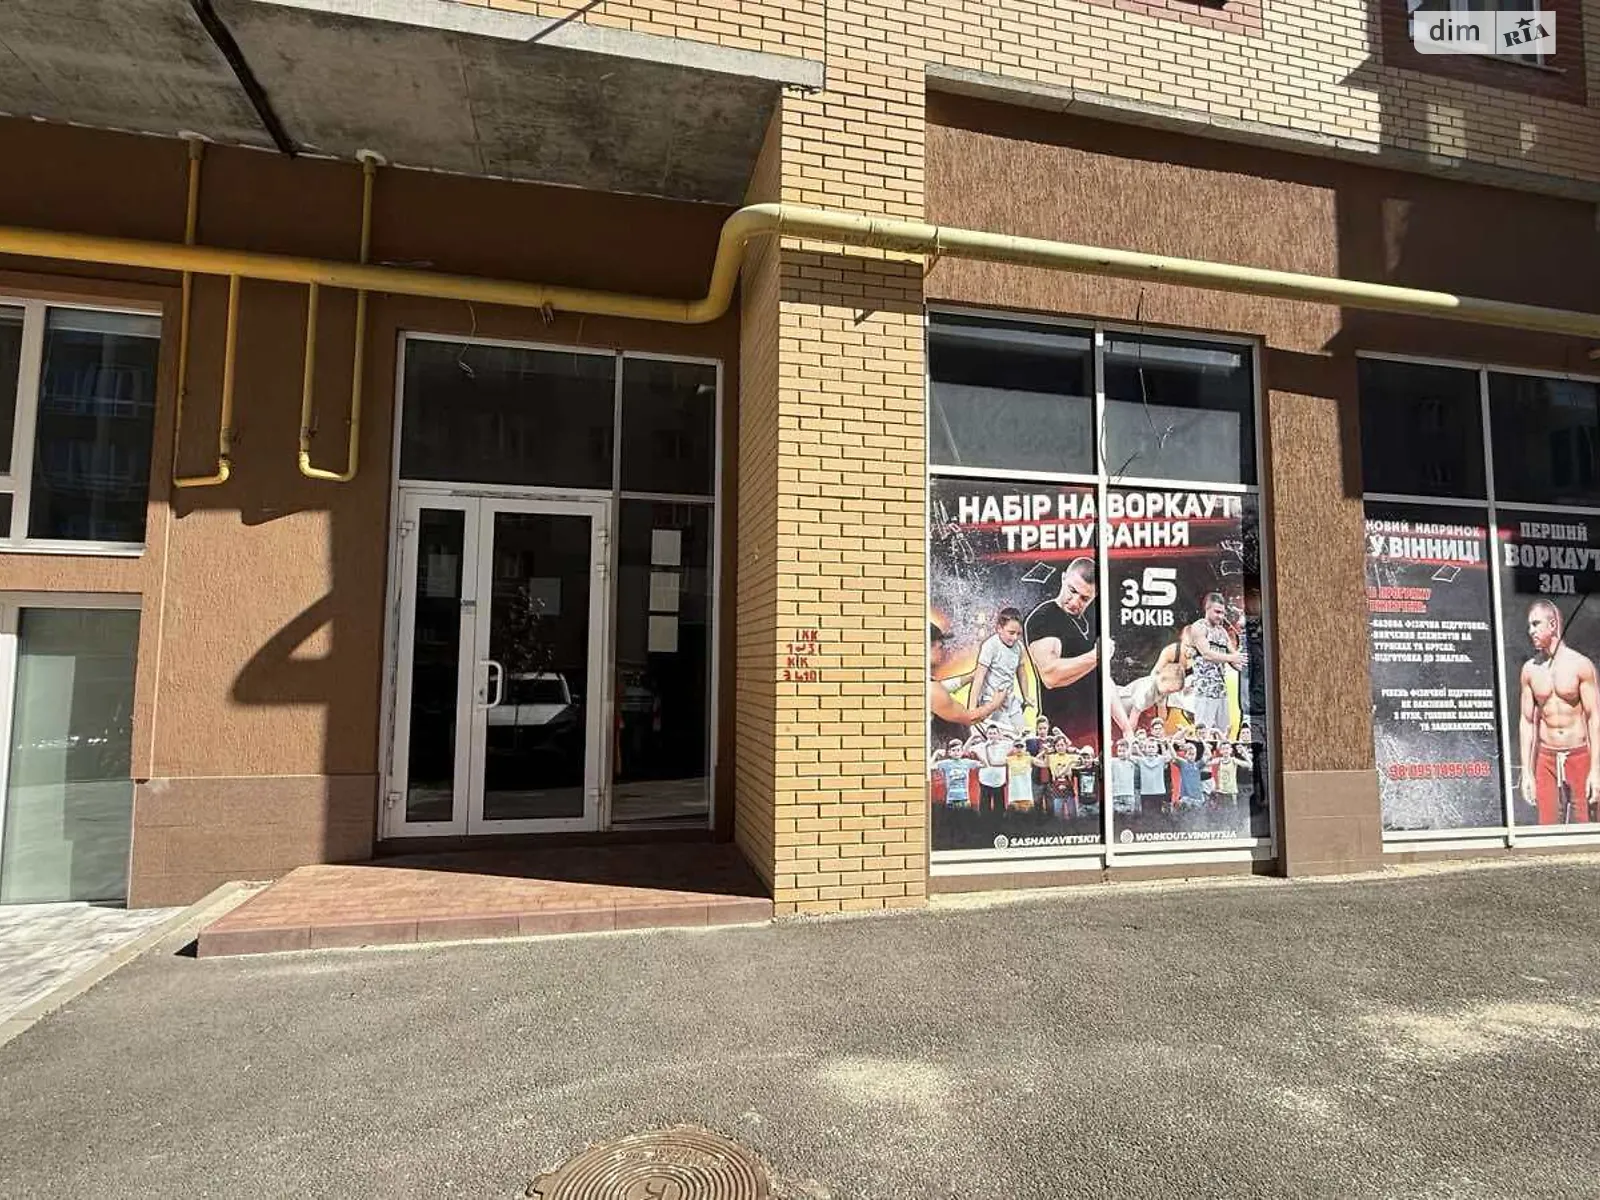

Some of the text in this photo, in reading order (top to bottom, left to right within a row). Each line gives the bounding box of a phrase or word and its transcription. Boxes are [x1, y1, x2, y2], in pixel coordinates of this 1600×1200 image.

[958, 492, 1240, 524] НАБІР НА ВОРКАУТ
[1001, 521, 1190, 552] ТРЕНУВАННЯ
[1415, 523, 1480, 538] НАПРЯМОК
[1519, 522, 1588, 541] ПЕРШИЙ
[1370, 535, 1480, 564] У ВІННИЦІ
[1539, 575, 1576, 594] ЗАЛ
[1121, 610, 1175, 627] РОКІВ
[1009, 834, 1101, 848] SASHAKAVETSKIY
